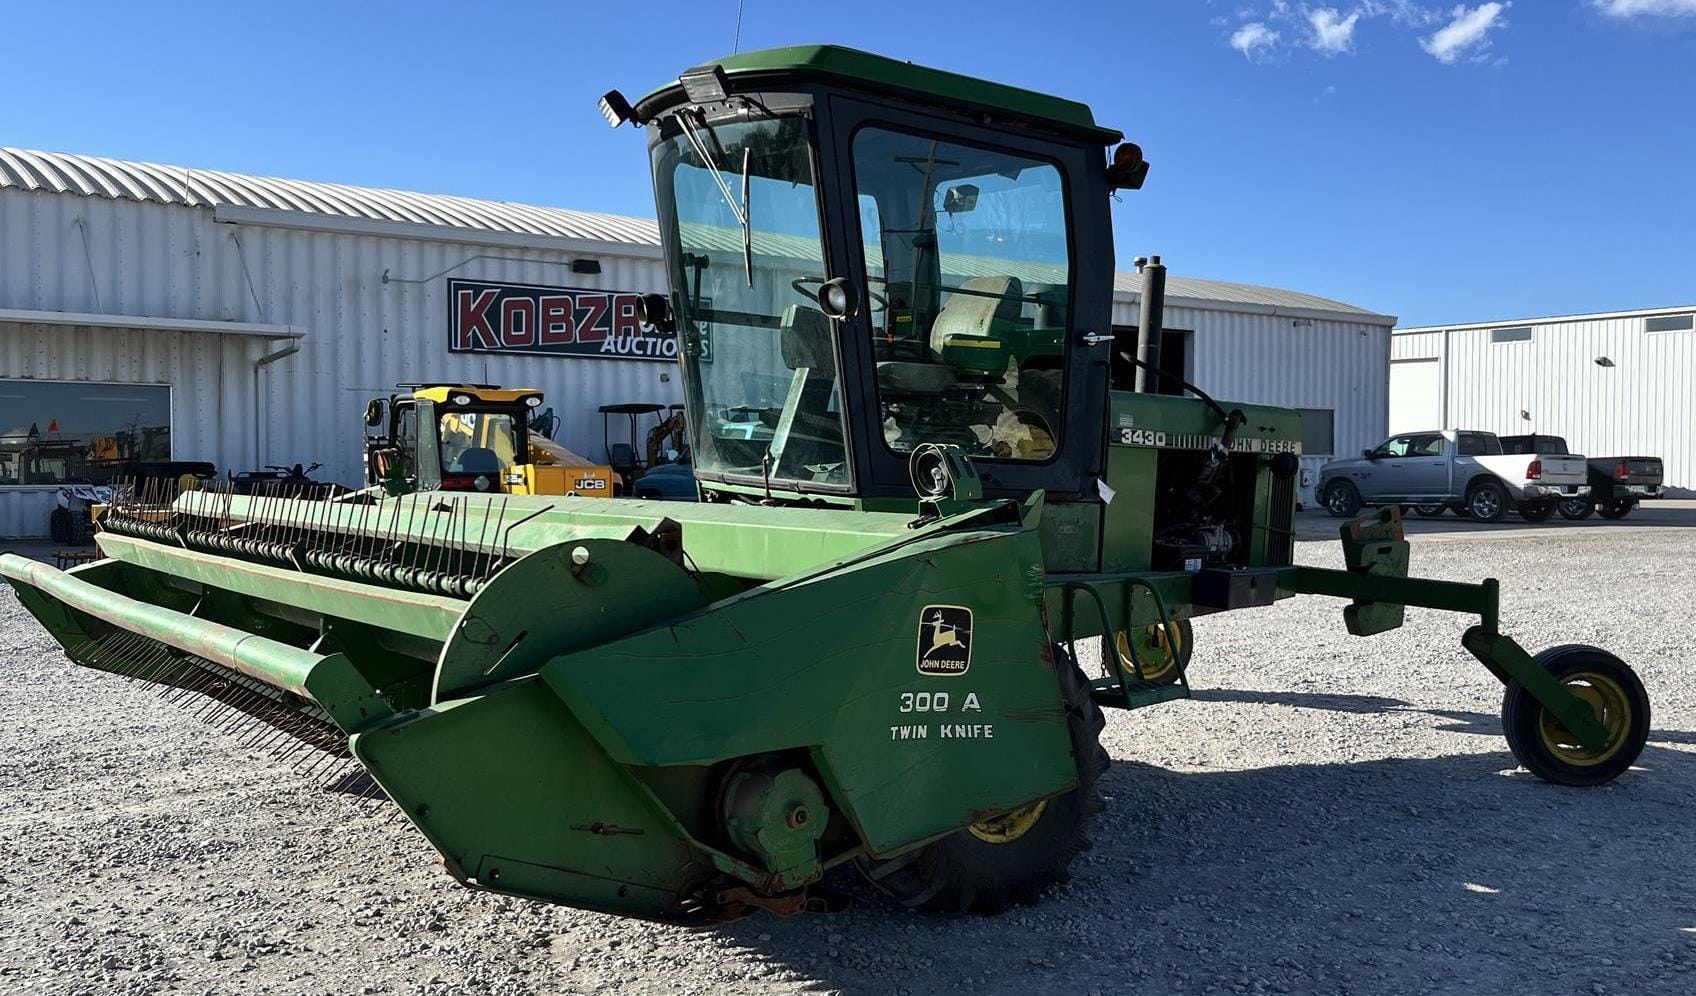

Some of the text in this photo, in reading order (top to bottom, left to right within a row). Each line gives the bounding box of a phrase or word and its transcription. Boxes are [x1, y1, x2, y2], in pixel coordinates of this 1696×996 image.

[600, 335, 709, 358] AUCTIOS
[1121, 428, 1166, 447] 3430
[1260, 439, 1296, 454] DEERE
[575, 480, 605, 489] JCB
[920, 659, 965, 669] JOHN DEERE
[900, 692, 982, 713] 300 A
[890, 724, 993, 740] TWIN KNIFE
